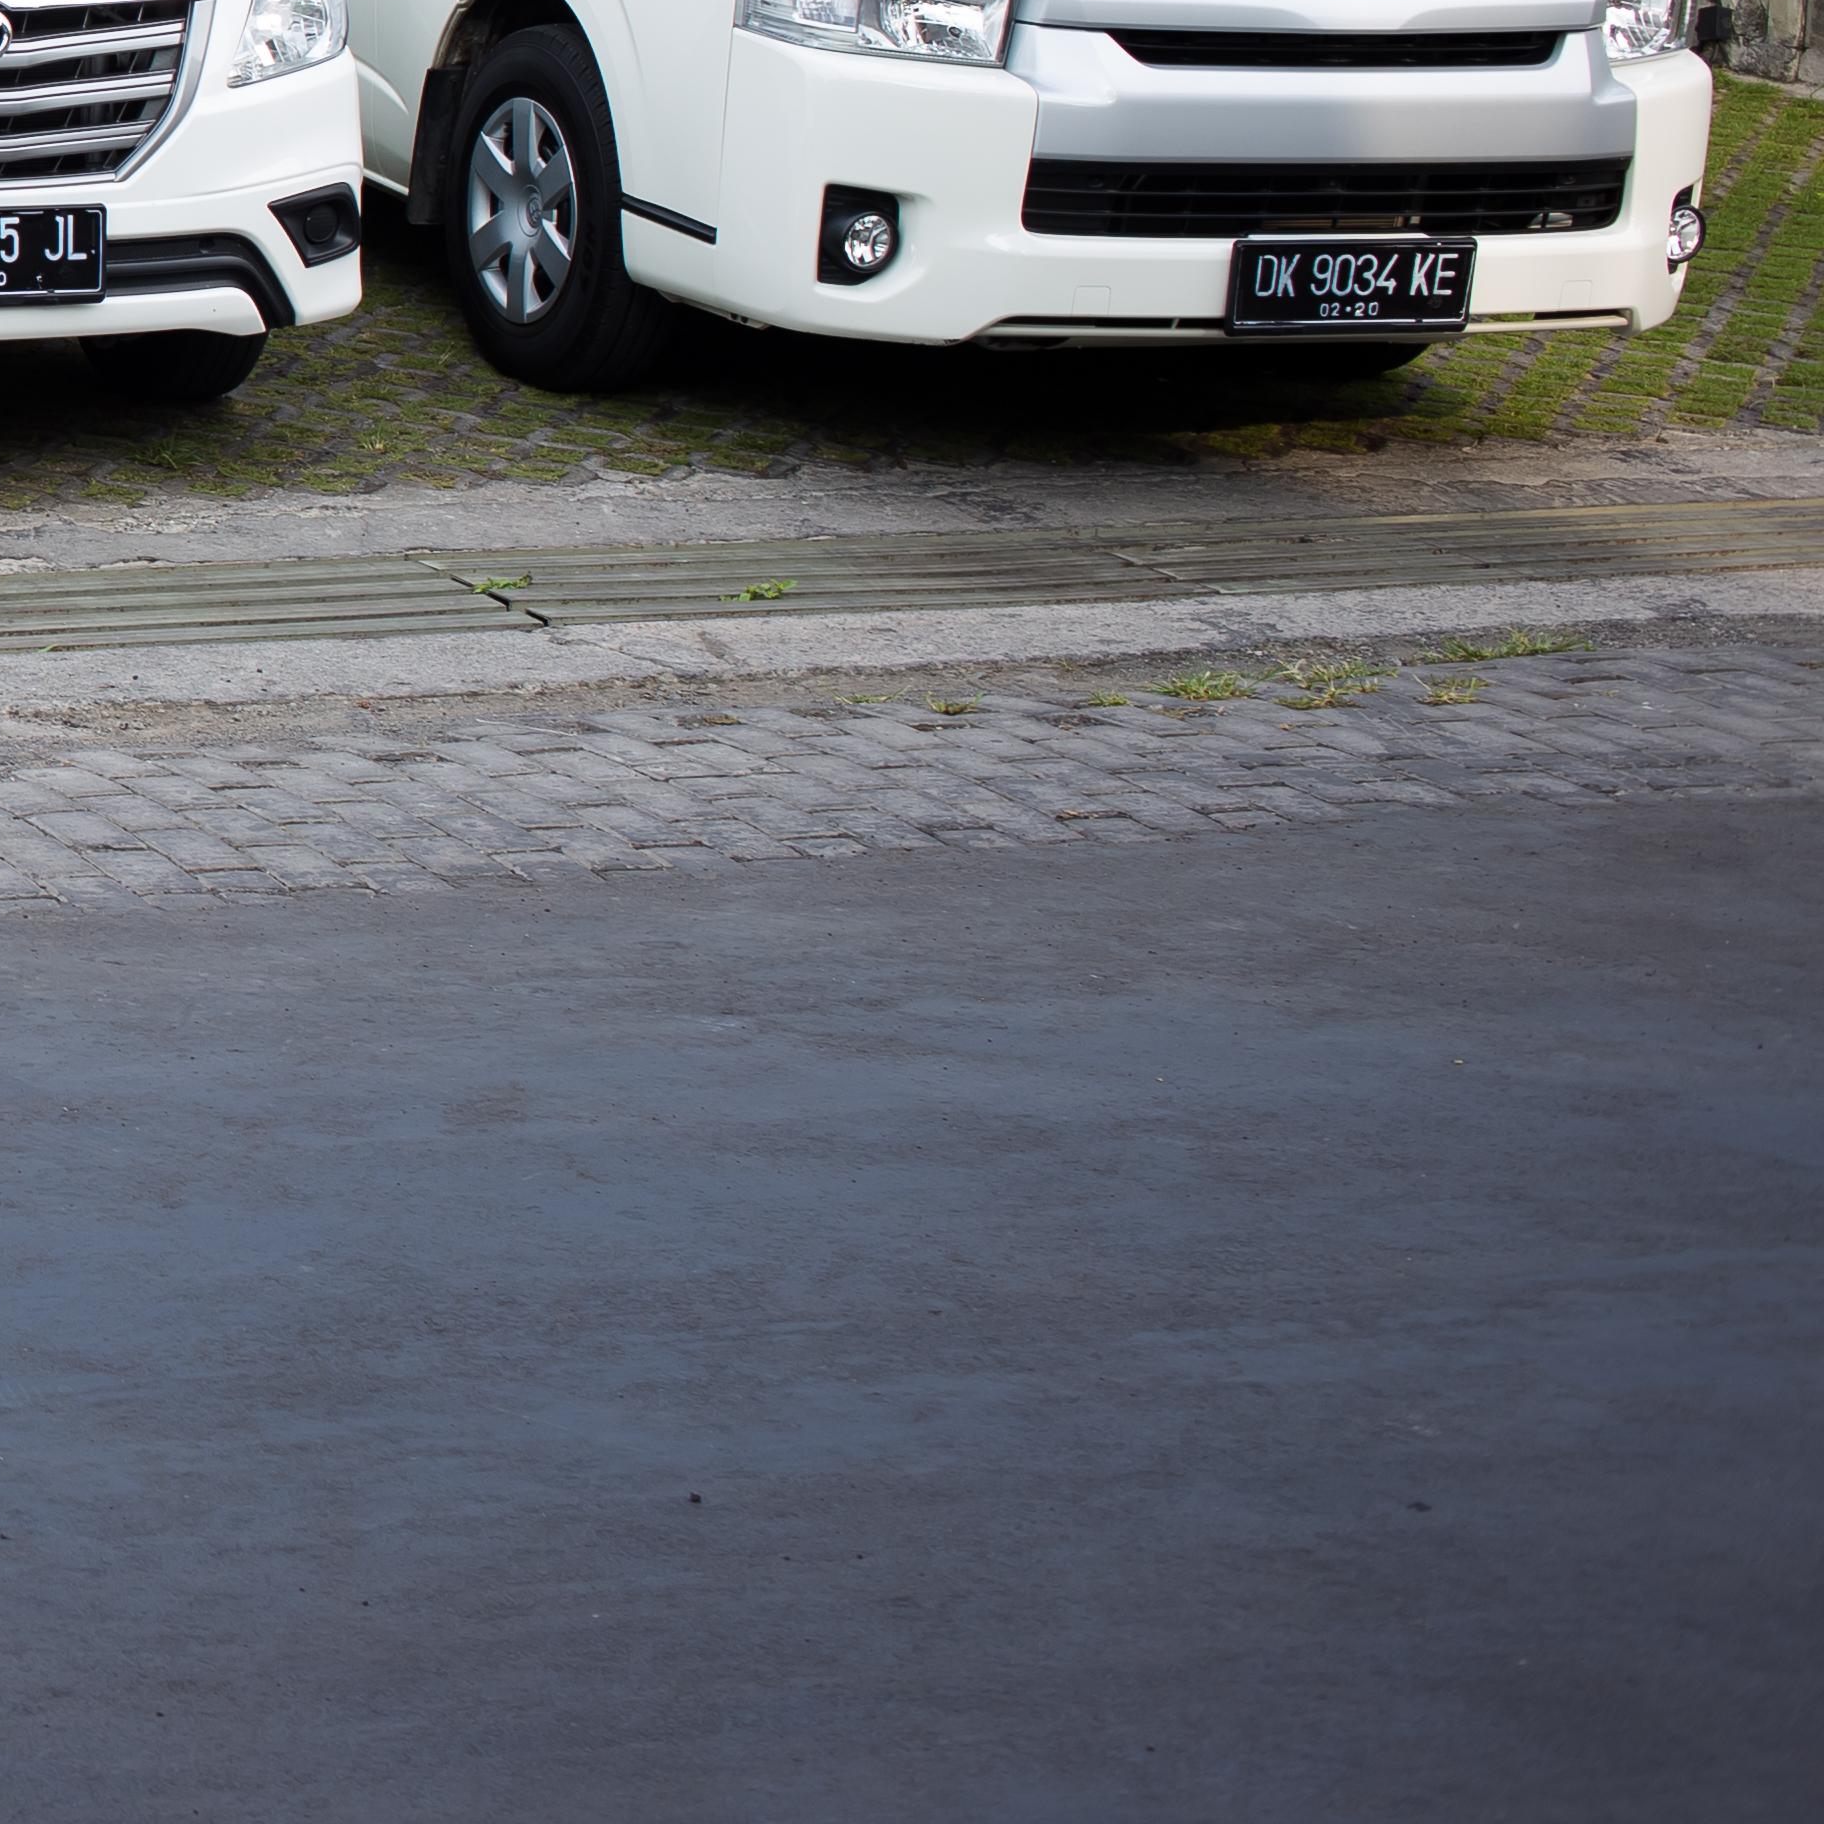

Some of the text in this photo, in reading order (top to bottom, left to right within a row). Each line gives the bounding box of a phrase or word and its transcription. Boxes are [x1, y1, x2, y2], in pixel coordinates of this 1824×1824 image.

[44, 214, 88, 262] JL
[1254, 252, 1459, 298] DK 9034 KE
